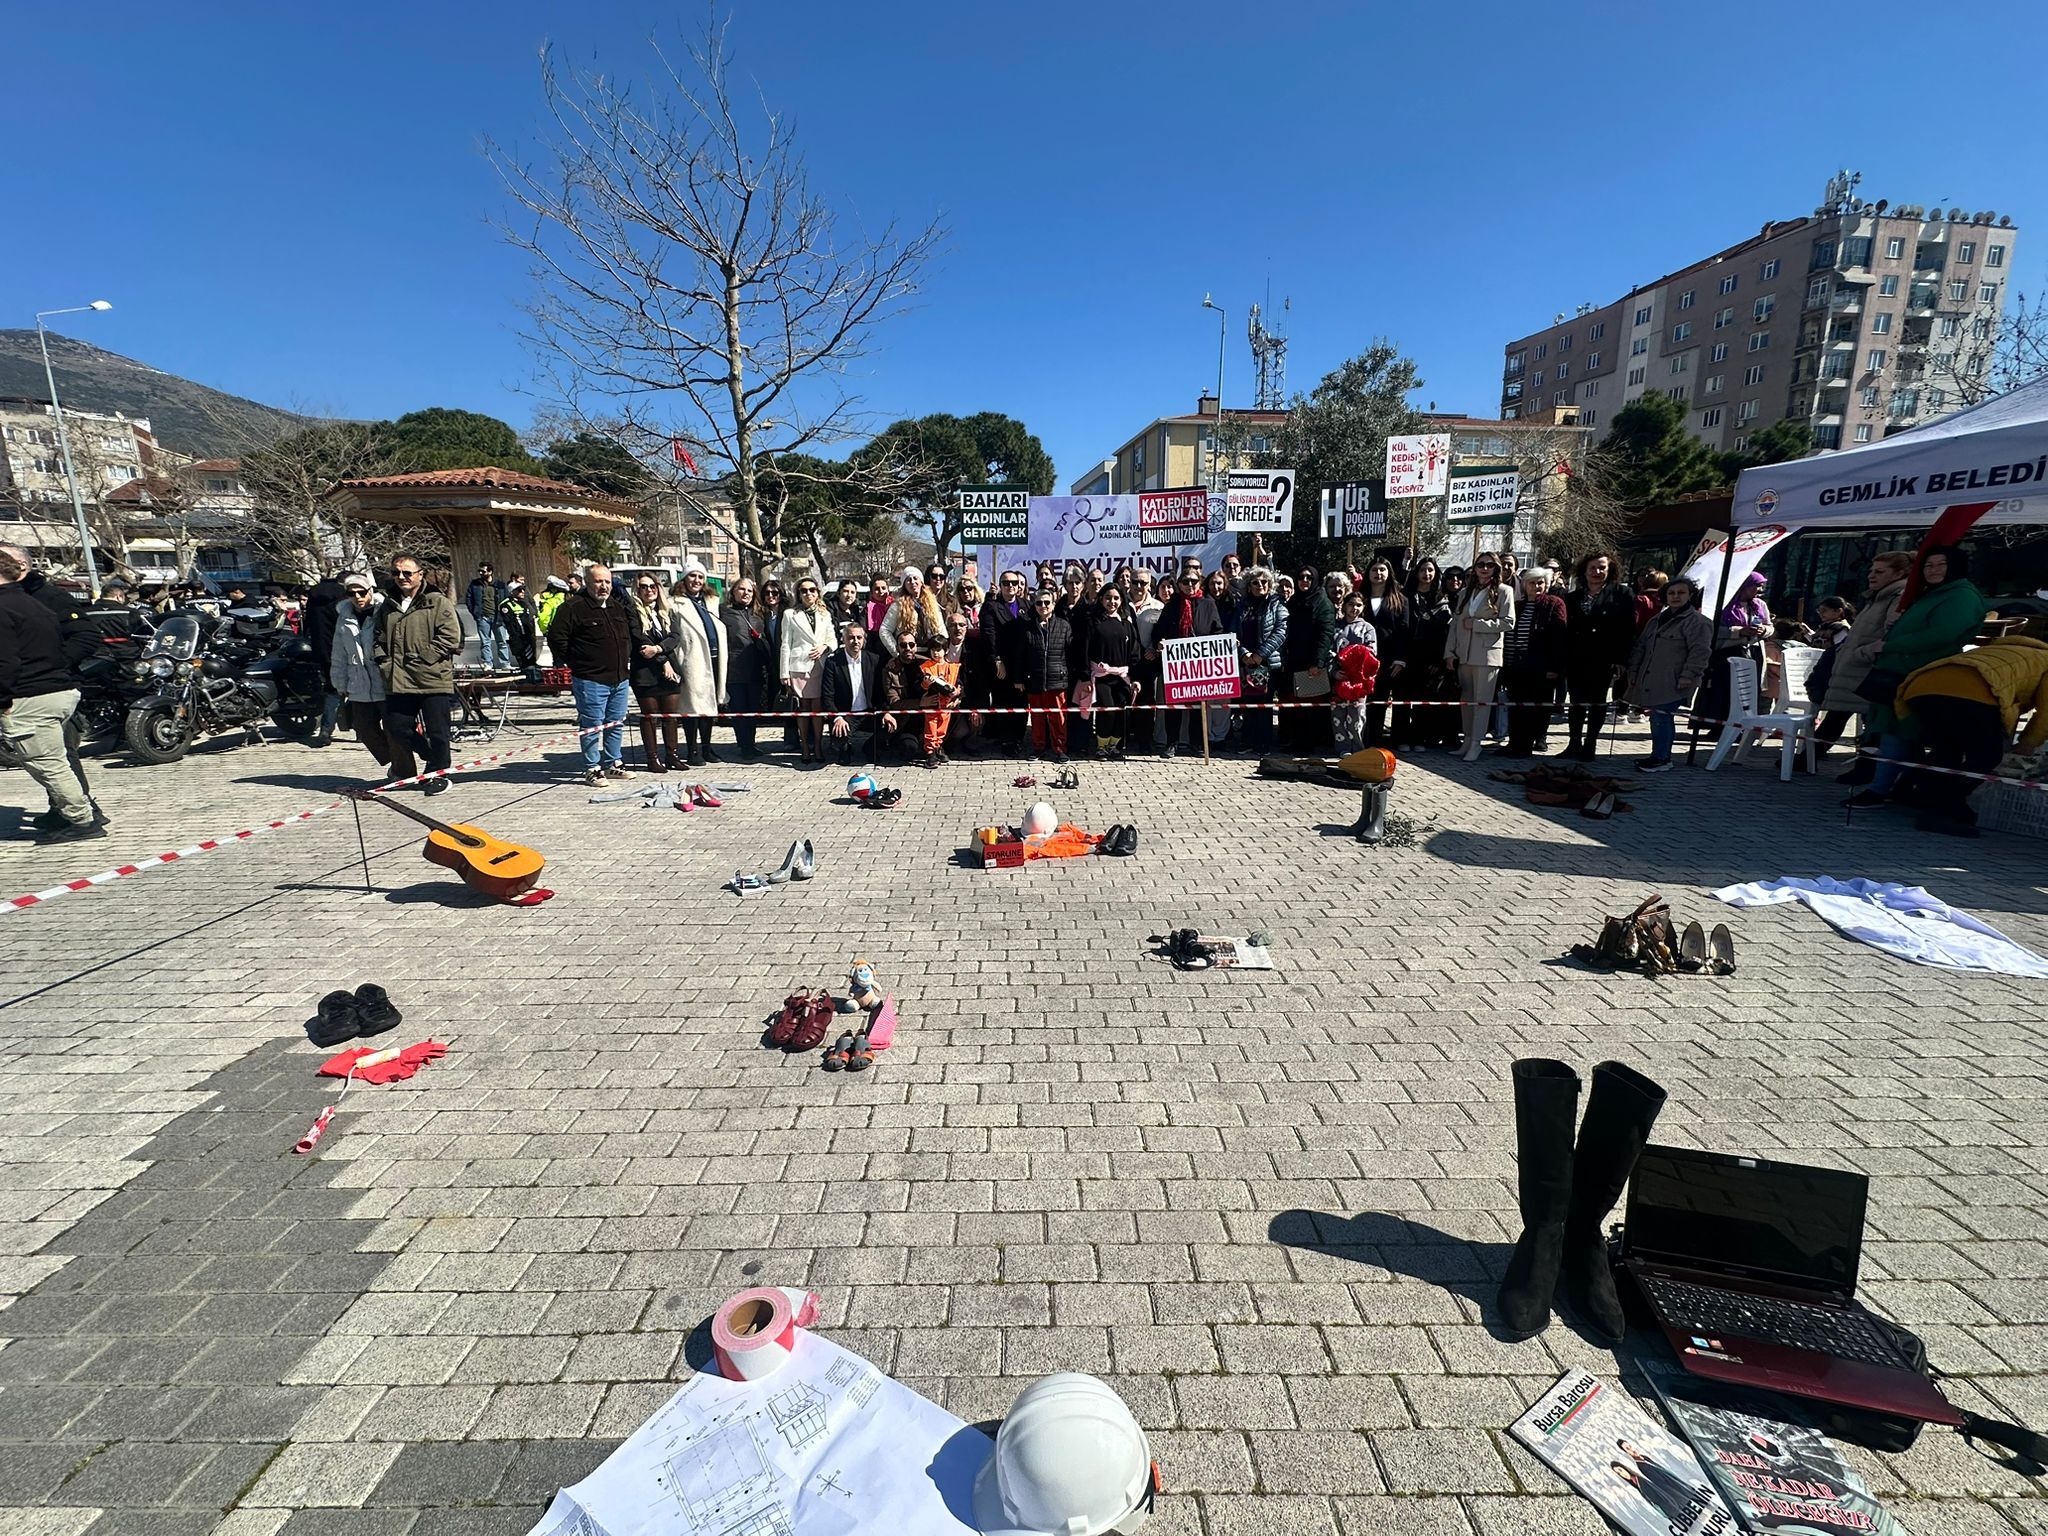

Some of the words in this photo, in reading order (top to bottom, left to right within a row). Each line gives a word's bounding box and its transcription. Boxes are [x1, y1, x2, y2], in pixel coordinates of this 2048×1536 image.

[1392, 441, 1408, 451] KÜL
[1391, 463, 1414, 473] DEĞİL
[1229, 477, 1267, 487] SORUYORUZ!
[1390, 475, 1401, 484] EV
[1453, 481, 1467, 490] BİZ
[1468, 476, 1515, 489] KADINLAR
[1819, 475, 1920, 506] GEMLİK
[1925, 455, 2047, 494] BELEDİ
[963, 493, 1027, 508] BAHARI
[1141, 494, 1205, 511] KATLEDİLEN
[1229, 493, 1257, 504] GÜLİSTAN
[1258, 495, 1275, 504] DOKU
[1451, 490, 1486, 504] BARIŞ
[1489, 486, 1514, 501] İÇİN
[1142, 507, 1205, 523] KADINLAR
[1228, 505, 1274, 522] NEREDE
[1450, 506, 1473, 515] ISRAR
[1474, 501, 1513, 512] EDİYORUZ
[963, 512, 1027, 524] KADINLAR
[1345, 510, 1384, 525] DOĞDUM
[963, 527, 1027, 538] GETİRECEK
[1119, 523, 1140, 531] DÜNYA
[1345, 523, 1386, 537] YAŞARIM
[1142, 526, 1205, 545] ONURUMUZDUR
[1165, 638, 1233, 661] KİMSENİN
[1167, 656, 1235, 682] NAMUSU
[1171, 681, 1235, 700] OLMAYACAĞIZ
[986, 849, 1022, 859] STARLINE
[1532, 1403, 1566, 1433] Bursa
[1557, 1374, 1596, 1411] Barosu
[1714, 1448, 1772, 1471] DAHA
[1728, 1469, 1764, 1490] NE
[1758, 1475, 1843, 1502] KADAR
